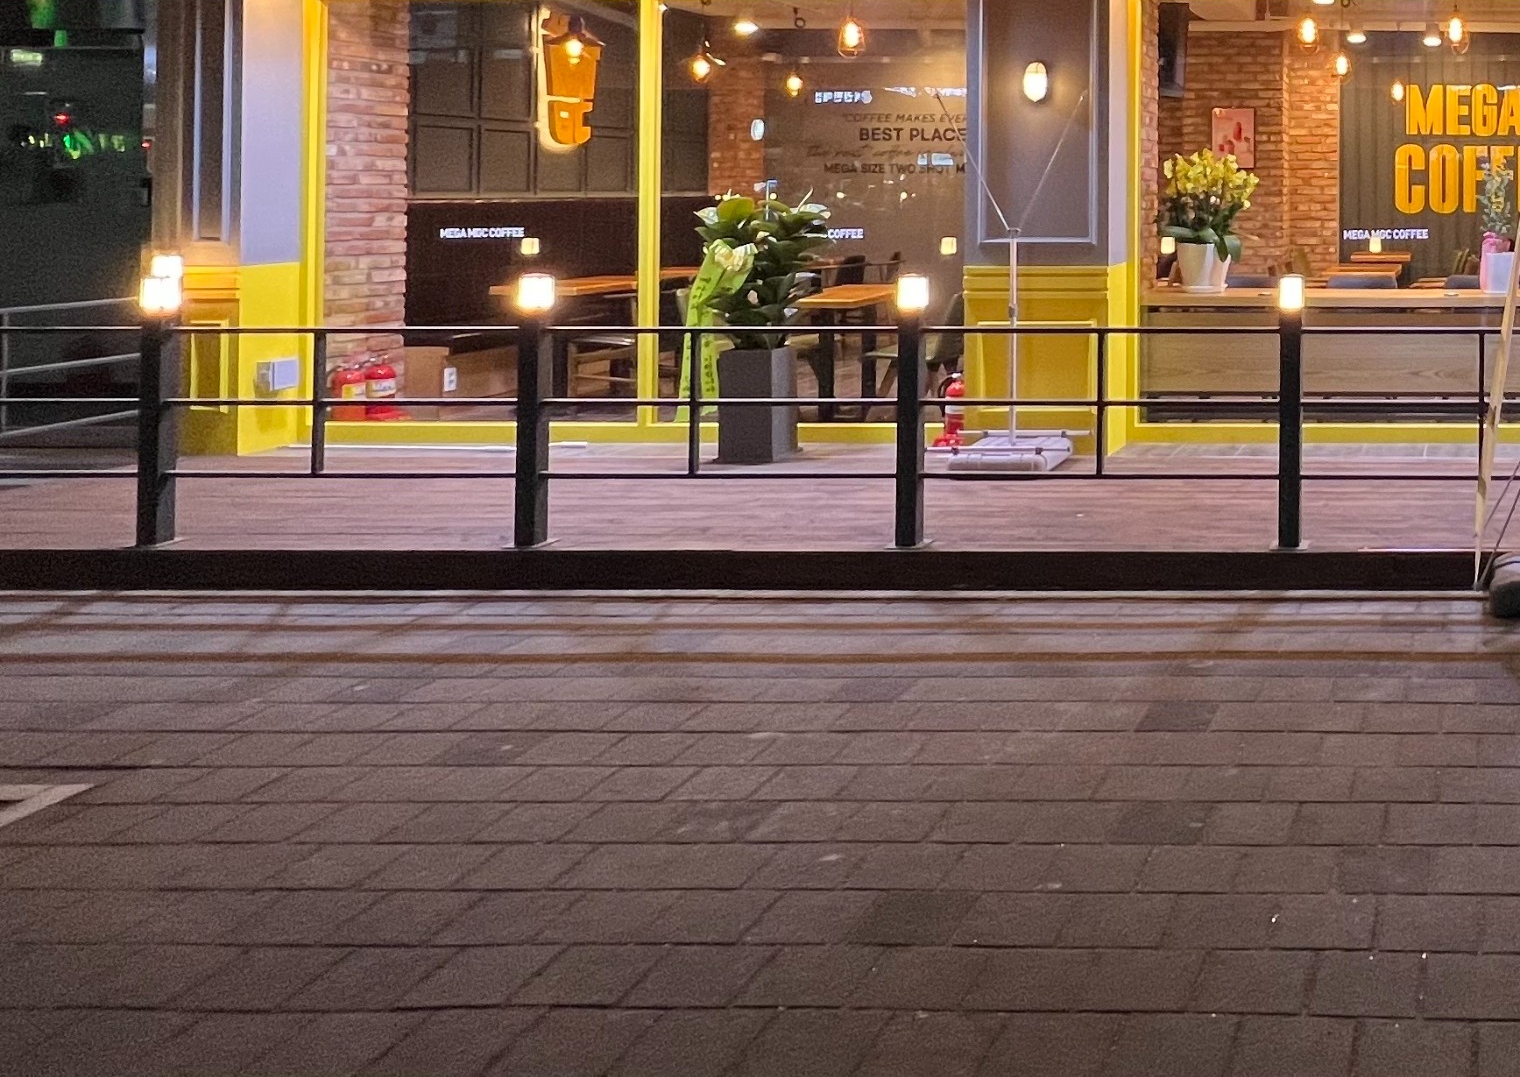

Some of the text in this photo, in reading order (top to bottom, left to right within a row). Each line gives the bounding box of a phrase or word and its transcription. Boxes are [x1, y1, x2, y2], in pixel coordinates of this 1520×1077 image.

[895, 112, 937, 123] MAKES
[859, 127, 967, 142] BEST PLACE
[824, 162, 858, 174] MEGA
[861, 162, 885, 174] SIZE
[889, 162, 916, 174] TWO
[440, 227, 467, 239] MEGA
[488, 226, 525, 238] COFFEE
[827, 228, 864, 239] COFFEE
[1343, 228, 1370, 241] MEGA
[1392, 228, 1429, 240] COFFEE
